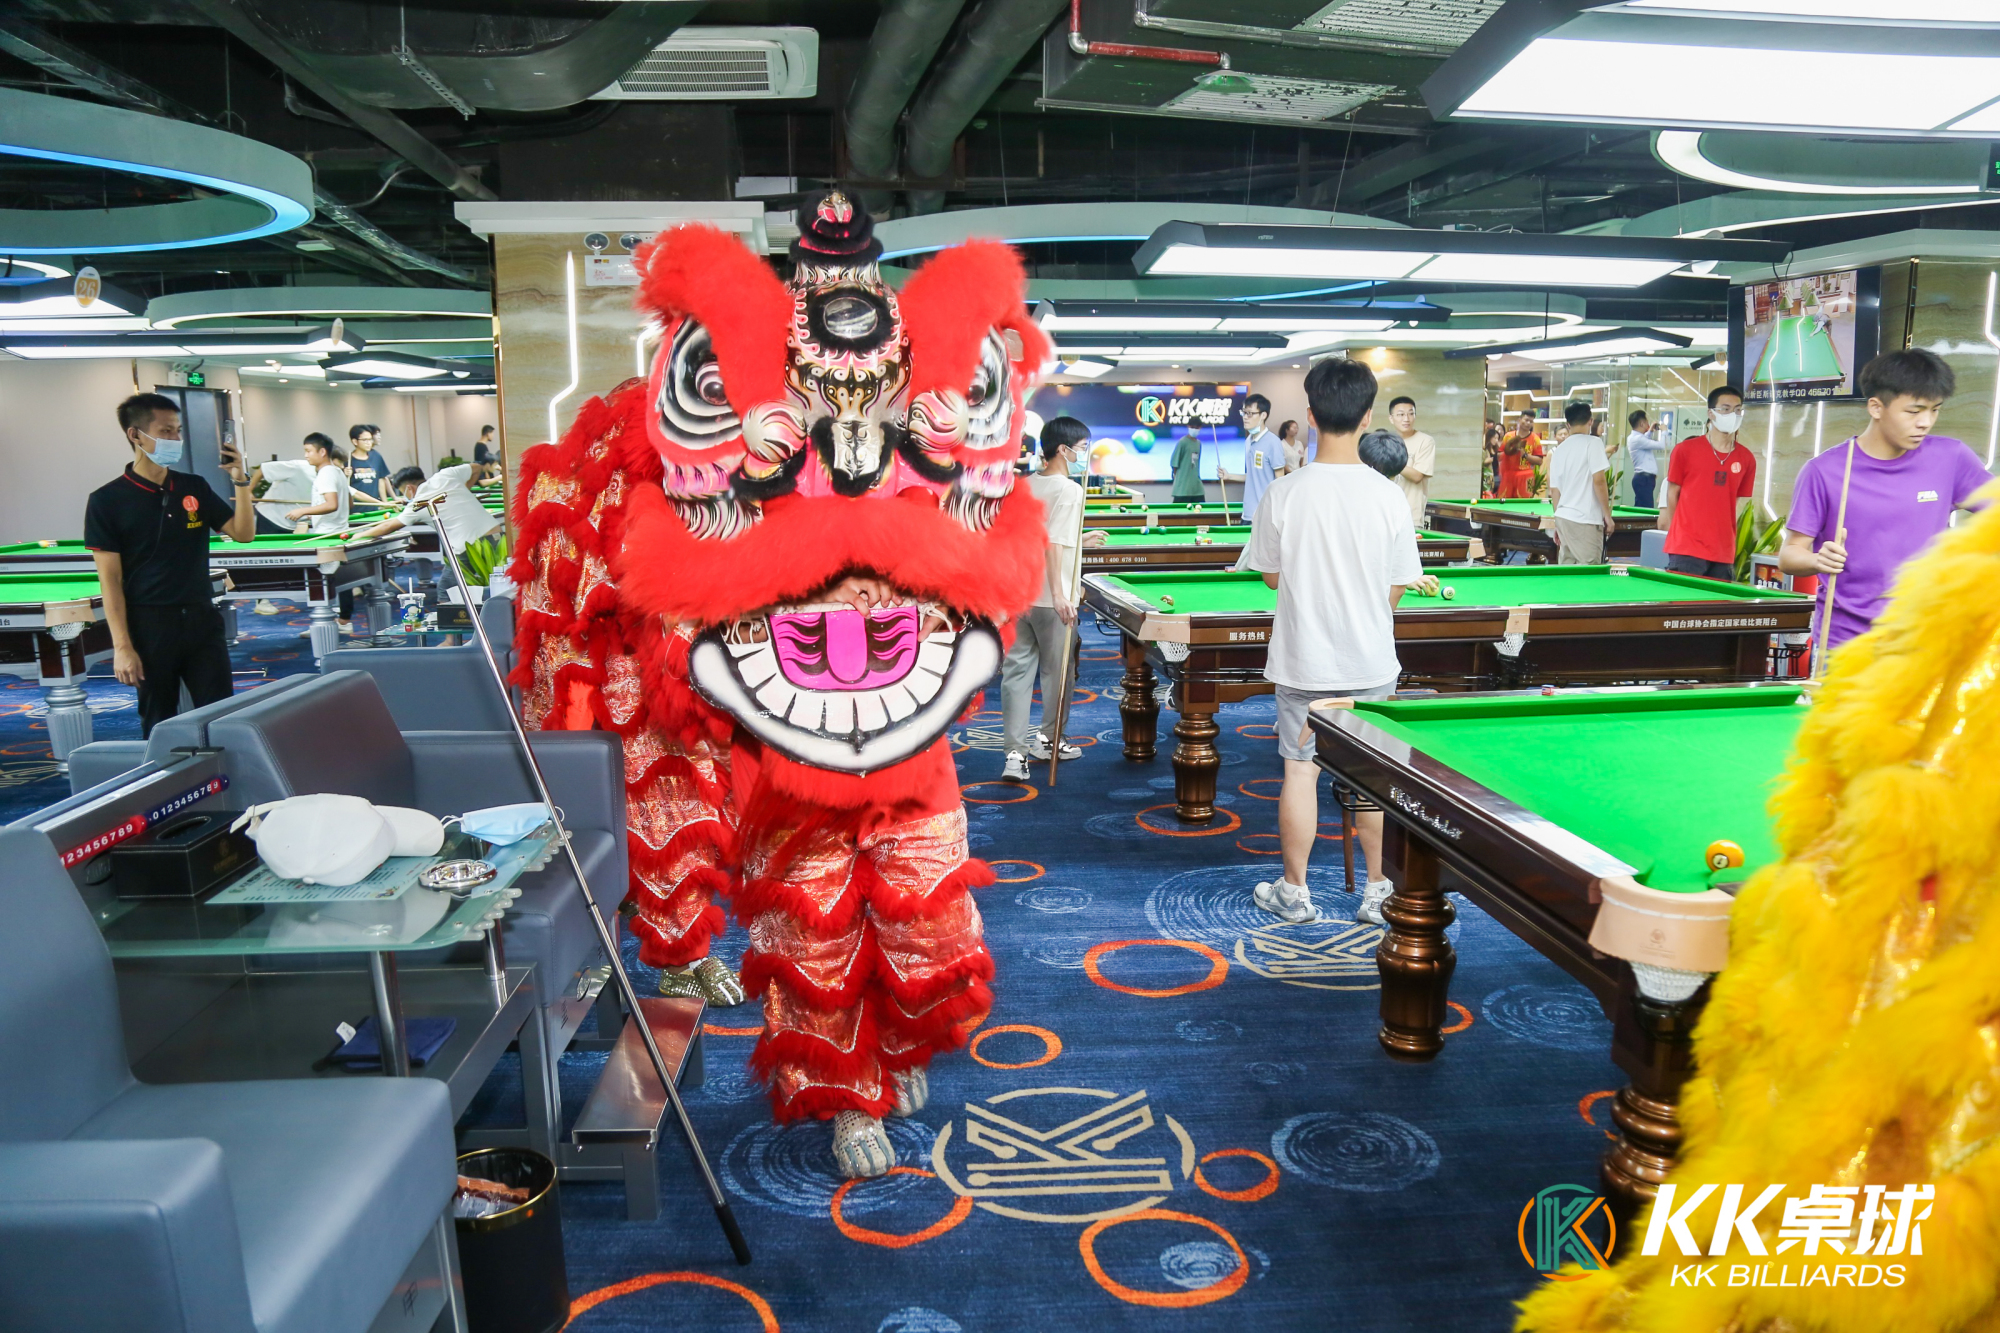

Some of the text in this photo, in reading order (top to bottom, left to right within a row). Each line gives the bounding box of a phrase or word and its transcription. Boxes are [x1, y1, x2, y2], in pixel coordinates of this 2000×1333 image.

[77, 279, 96, 300] 26
[1663, 617, 1778, 629] 中国台球协会指定国家级比赛用台
